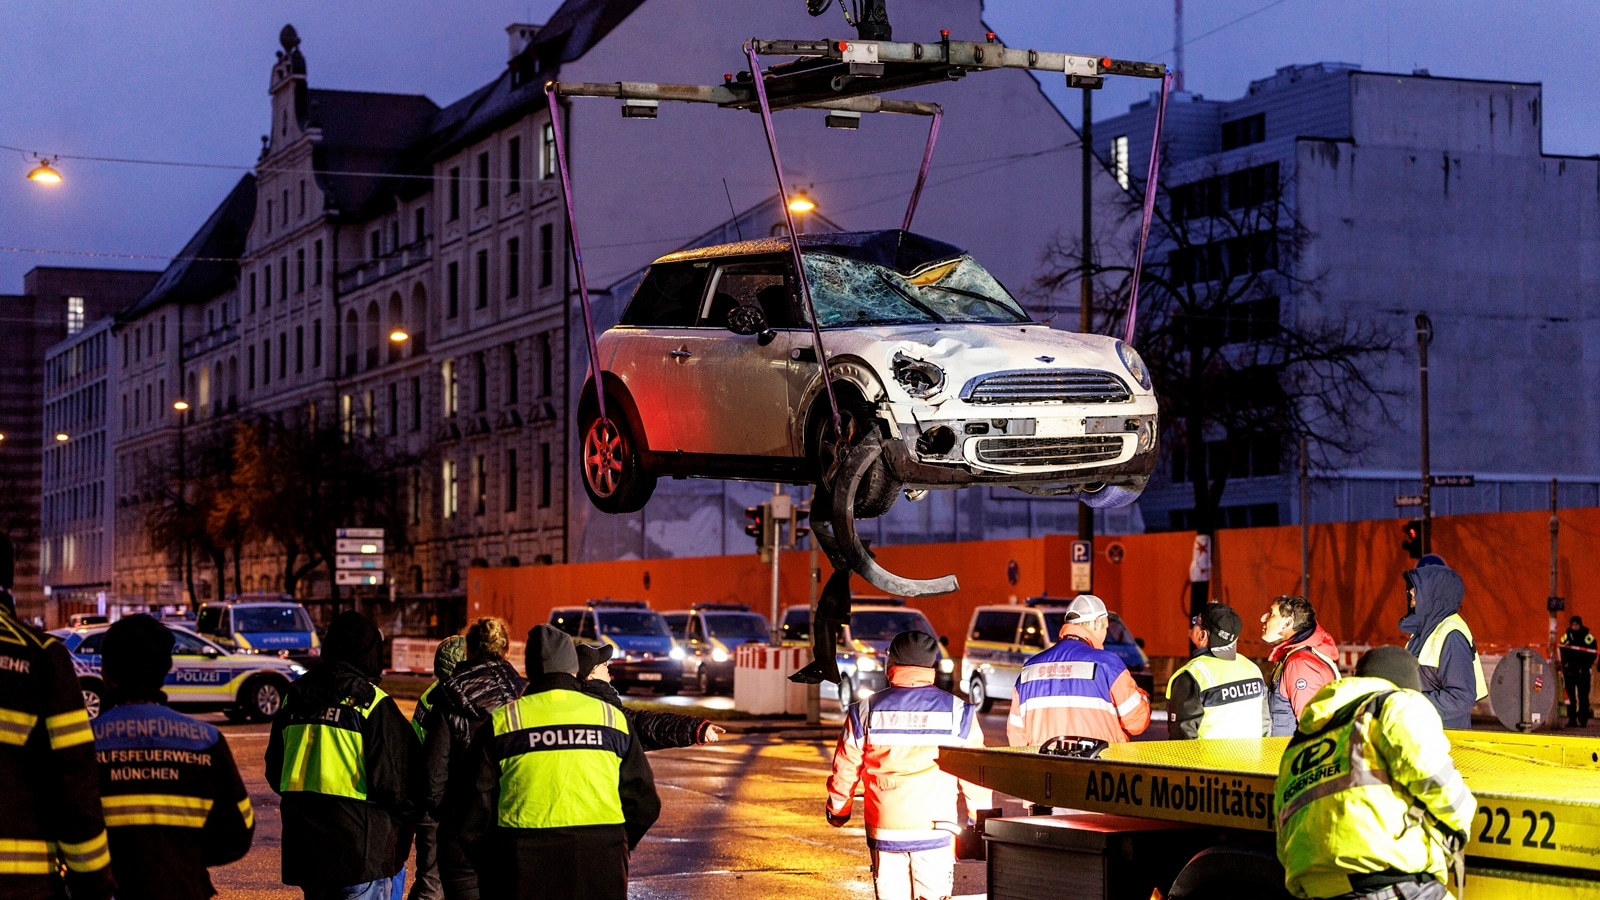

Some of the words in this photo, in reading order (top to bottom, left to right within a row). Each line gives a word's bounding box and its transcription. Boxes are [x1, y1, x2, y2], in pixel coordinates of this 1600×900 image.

[176, 671, 220, 683] POLIZEI
[1221, 682, 1261, 700] POLIZEI
[529, 729, 603, 747] POLIZEI
[110, 766, 179, 780] MÜNCHEN
[1085, 770, 1143, 806] ADAC
[1478, 806, 1511, 845] 22
[1522, 809, 1556, 850] 22
